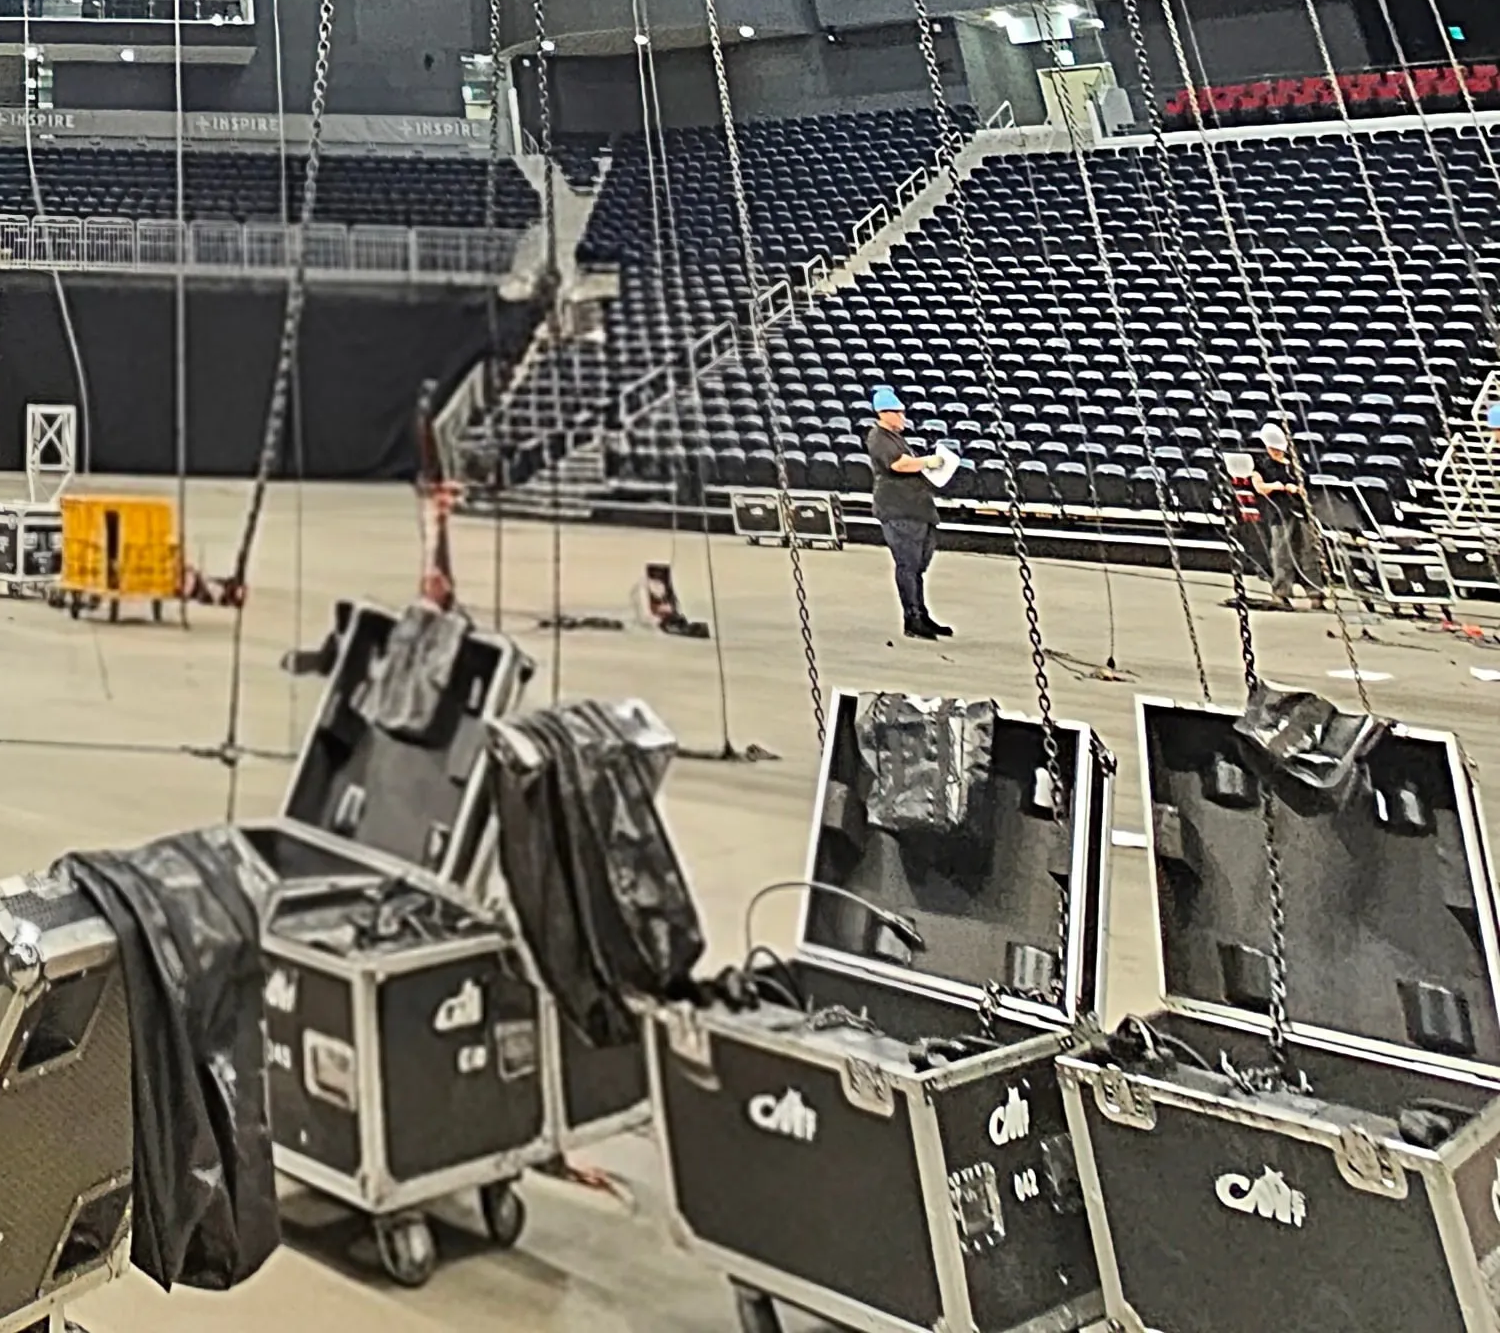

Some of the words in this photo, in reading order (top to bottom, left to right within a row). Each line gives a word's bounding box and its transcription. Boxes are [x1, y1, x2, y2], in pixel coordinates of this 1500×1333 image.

[11, 113, 75, 129] INSPIRE
[213, 116, 279, 132] INSPIRE
[415, 121, 480, 137] INSPIRE
